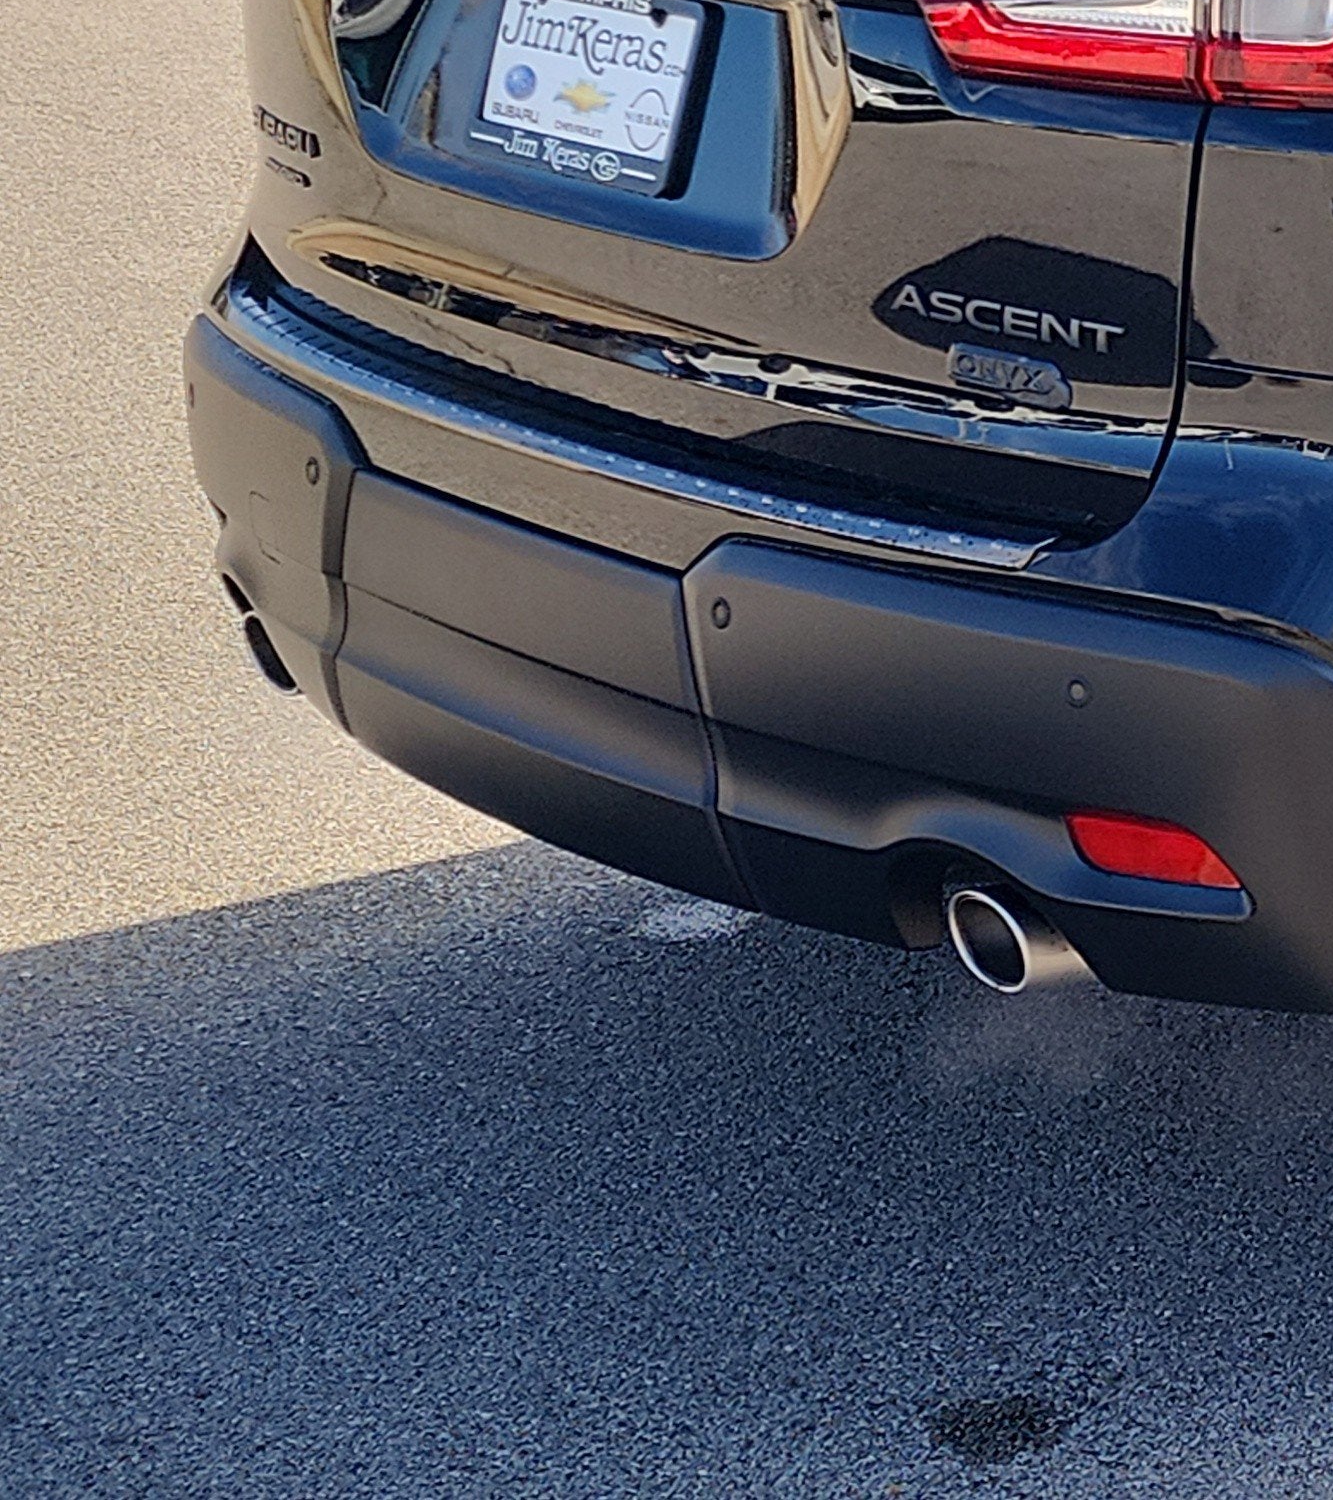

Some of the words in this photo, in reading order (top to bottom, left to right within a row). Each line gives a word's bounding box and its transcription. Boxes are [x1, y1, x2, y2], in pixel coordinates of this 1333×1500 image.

[624, 110, 670, 128] NISSAN
[503, 129, 538, 159] Jim
[543, 137, 591, 171] Keras
[890, 284, 1126, 354] ASCENT
[956, 354, 1046, 390] ONYX
